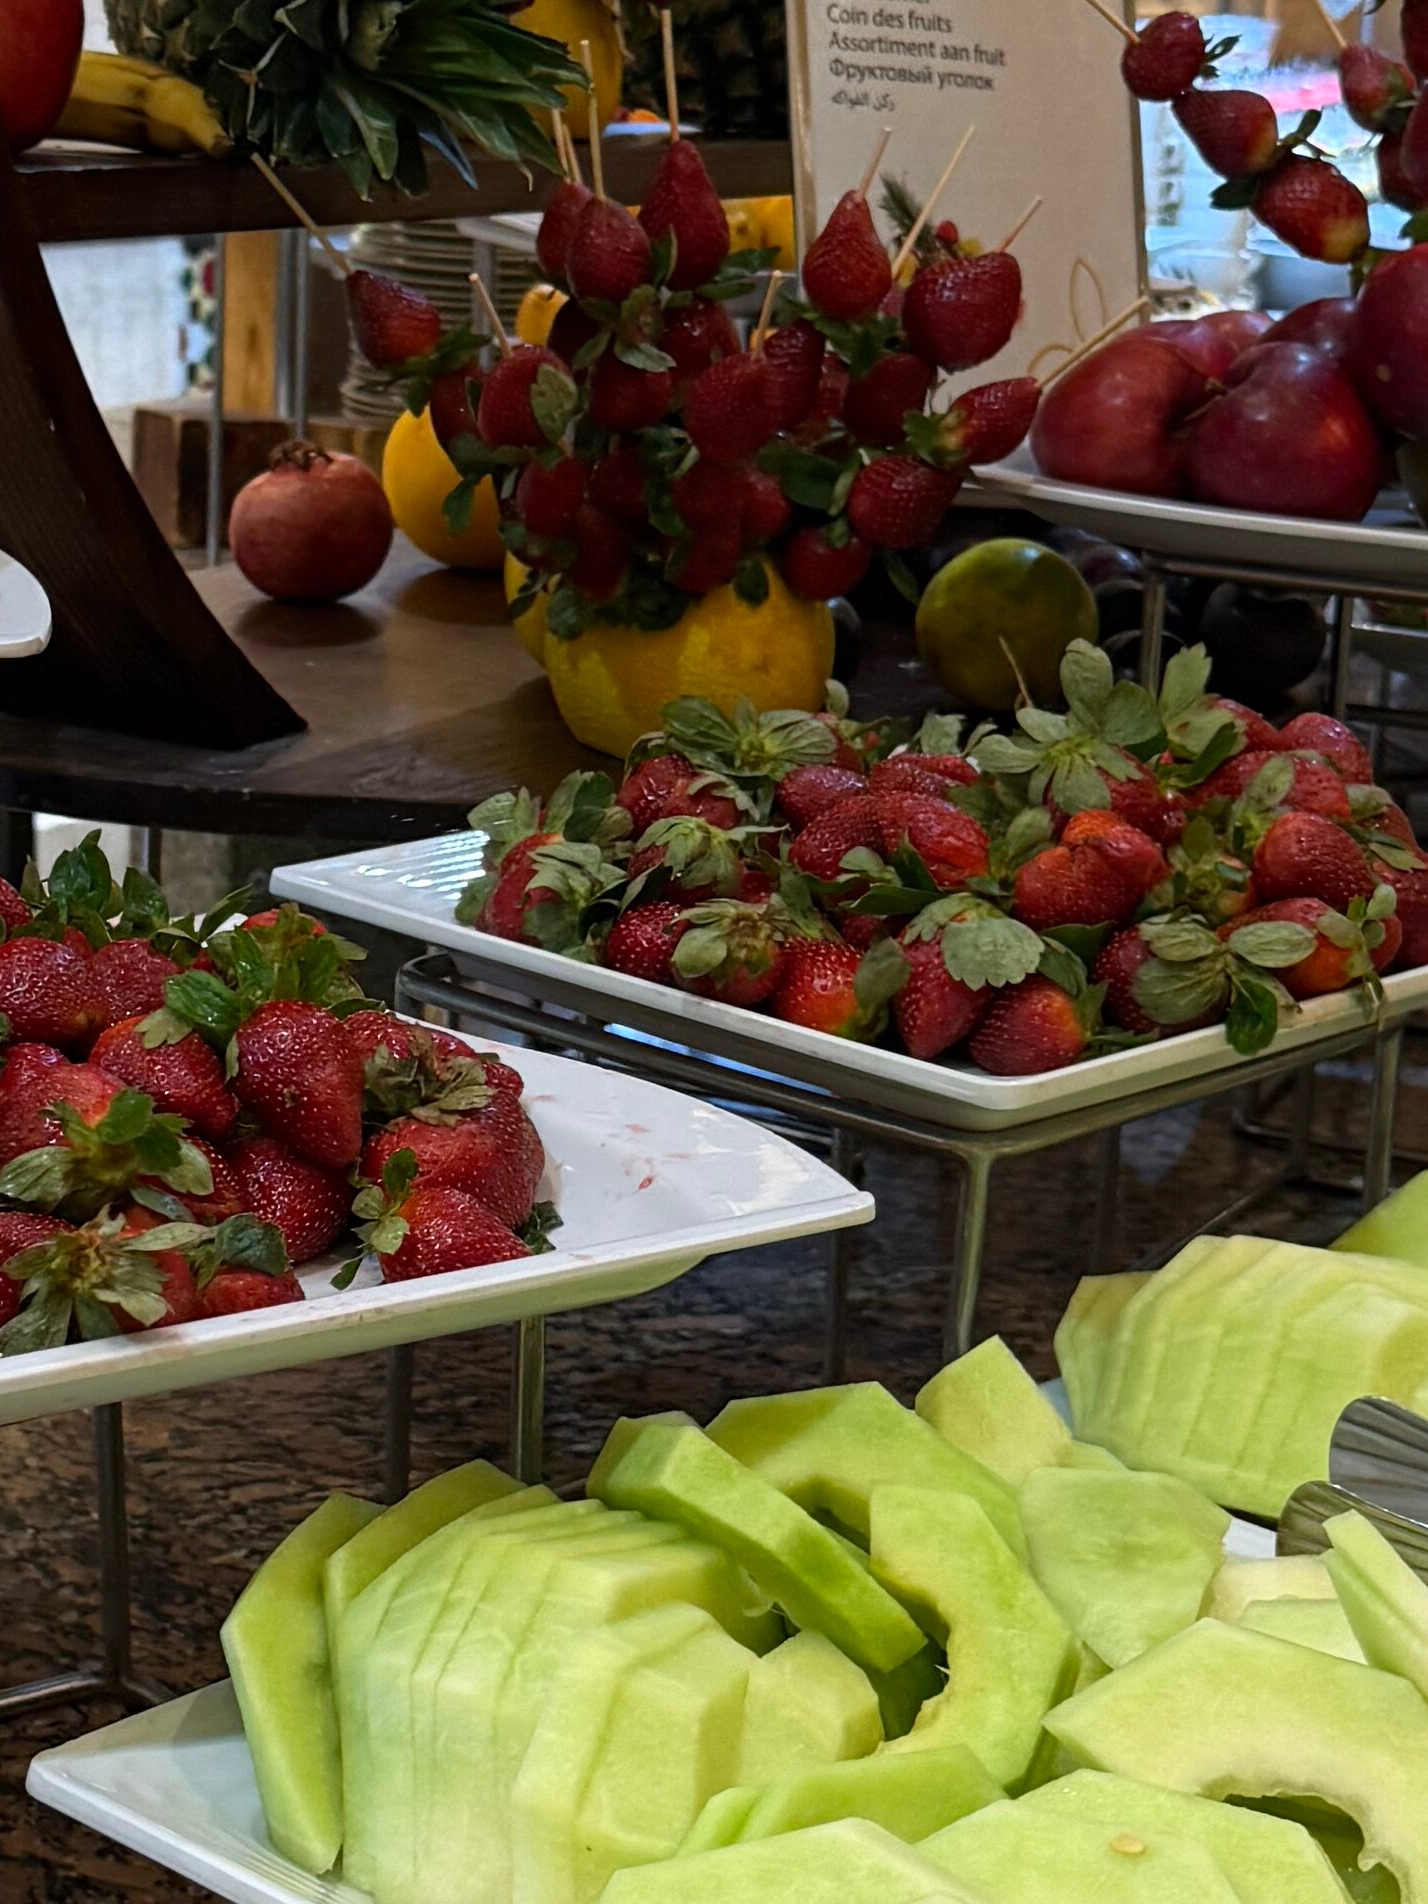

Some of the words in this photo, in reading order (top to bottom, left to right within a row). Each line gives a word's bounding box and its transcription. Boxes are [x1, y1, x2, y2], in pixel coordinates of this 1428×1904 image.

[826, 3, 868, 26] Coin
[872, 8, 904, 29] des
[908, 10, 953, 33] fruits
[829, 31, 936, 58] Assortiment
[940, 45, 971, 62] aan
[974, 43, 1006, 66] fruit
[829, 58, 933, 84] Фруктовый
